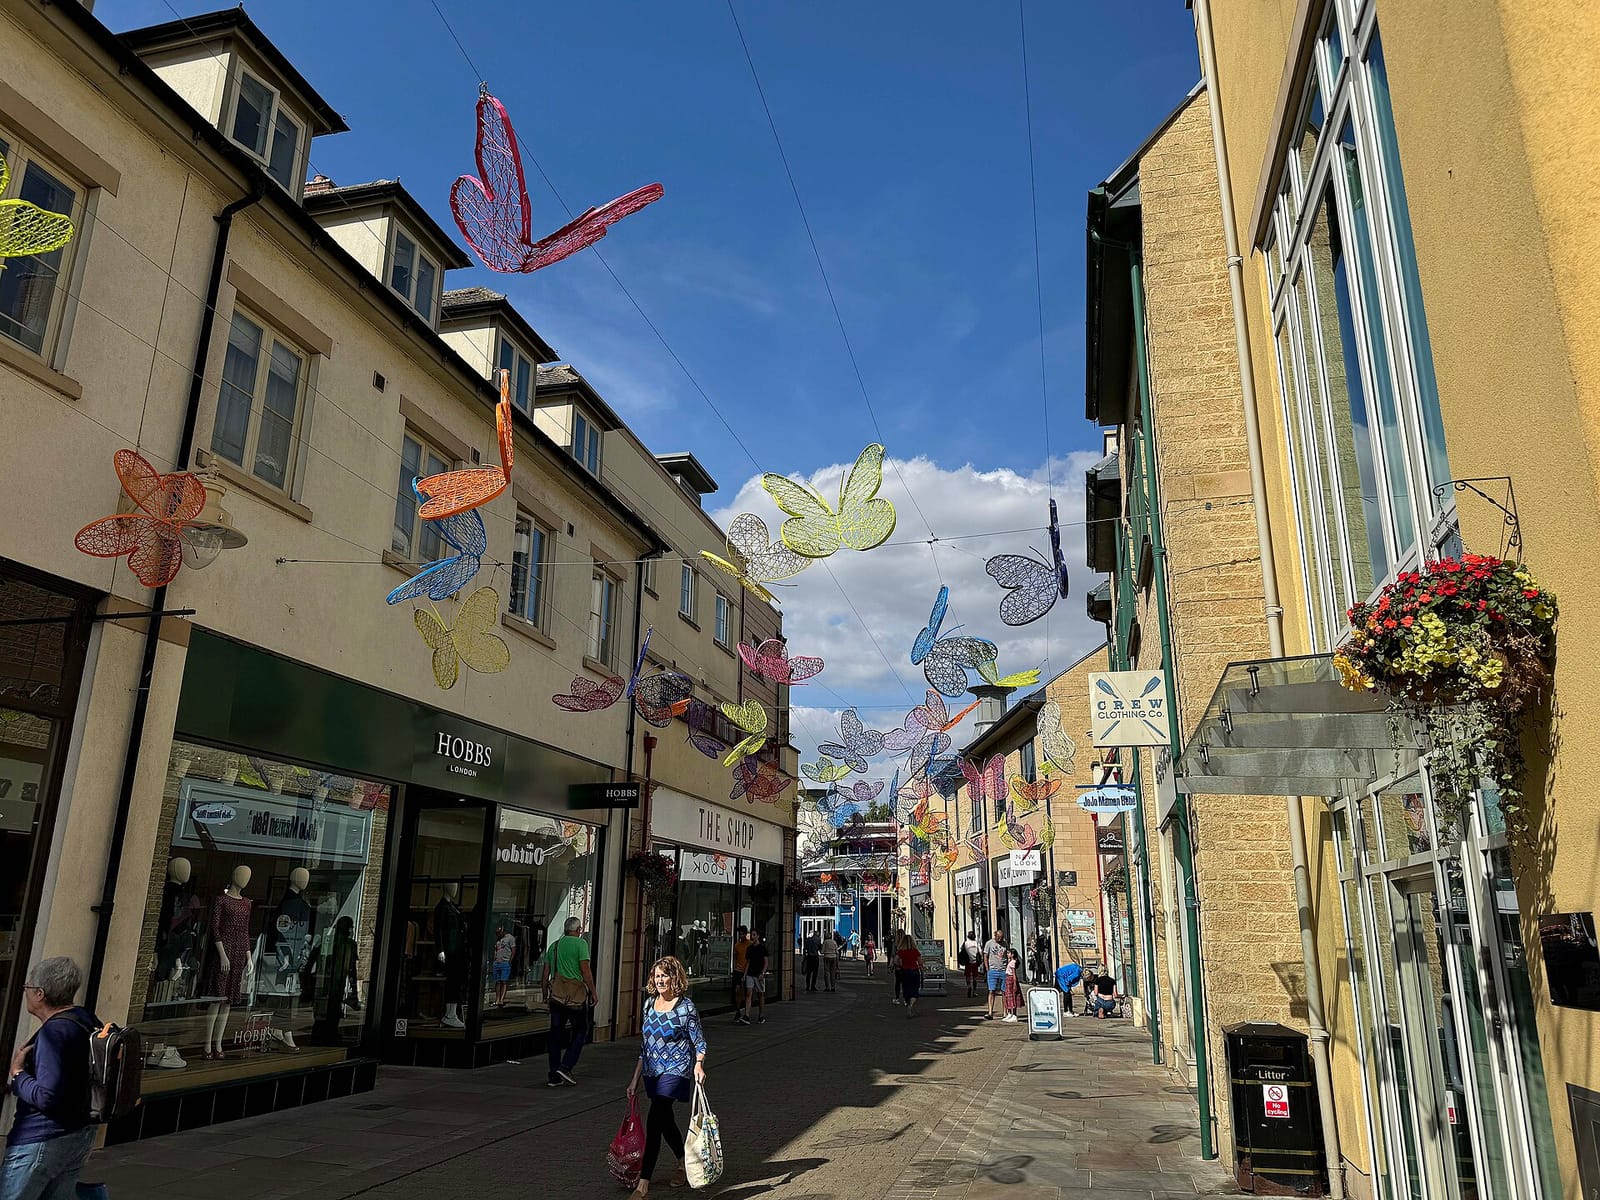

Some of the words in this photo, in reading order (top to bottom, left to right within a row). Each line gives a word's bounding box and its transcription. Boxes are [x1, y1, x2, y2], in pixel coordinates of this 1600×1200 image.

[1097, 698, 1163, 711] CREW
[1097, 710, 1147, 720] CLOTHING
[1148, 710, 1165, 718] Co.
[436, 731, 493, 767] HOBBS
[450, 764, 478, 777] LONDON
[605, 789, 638, 798] HOBBS
[1083, 796, 1098, 807] JoJo
[699, 807, 721, 843] THE
[727, 817, 754, 850] SHOP
[233, 1026, 272, 1044] HOBBS
[1258, 1070, 1286, 1080] Litter
